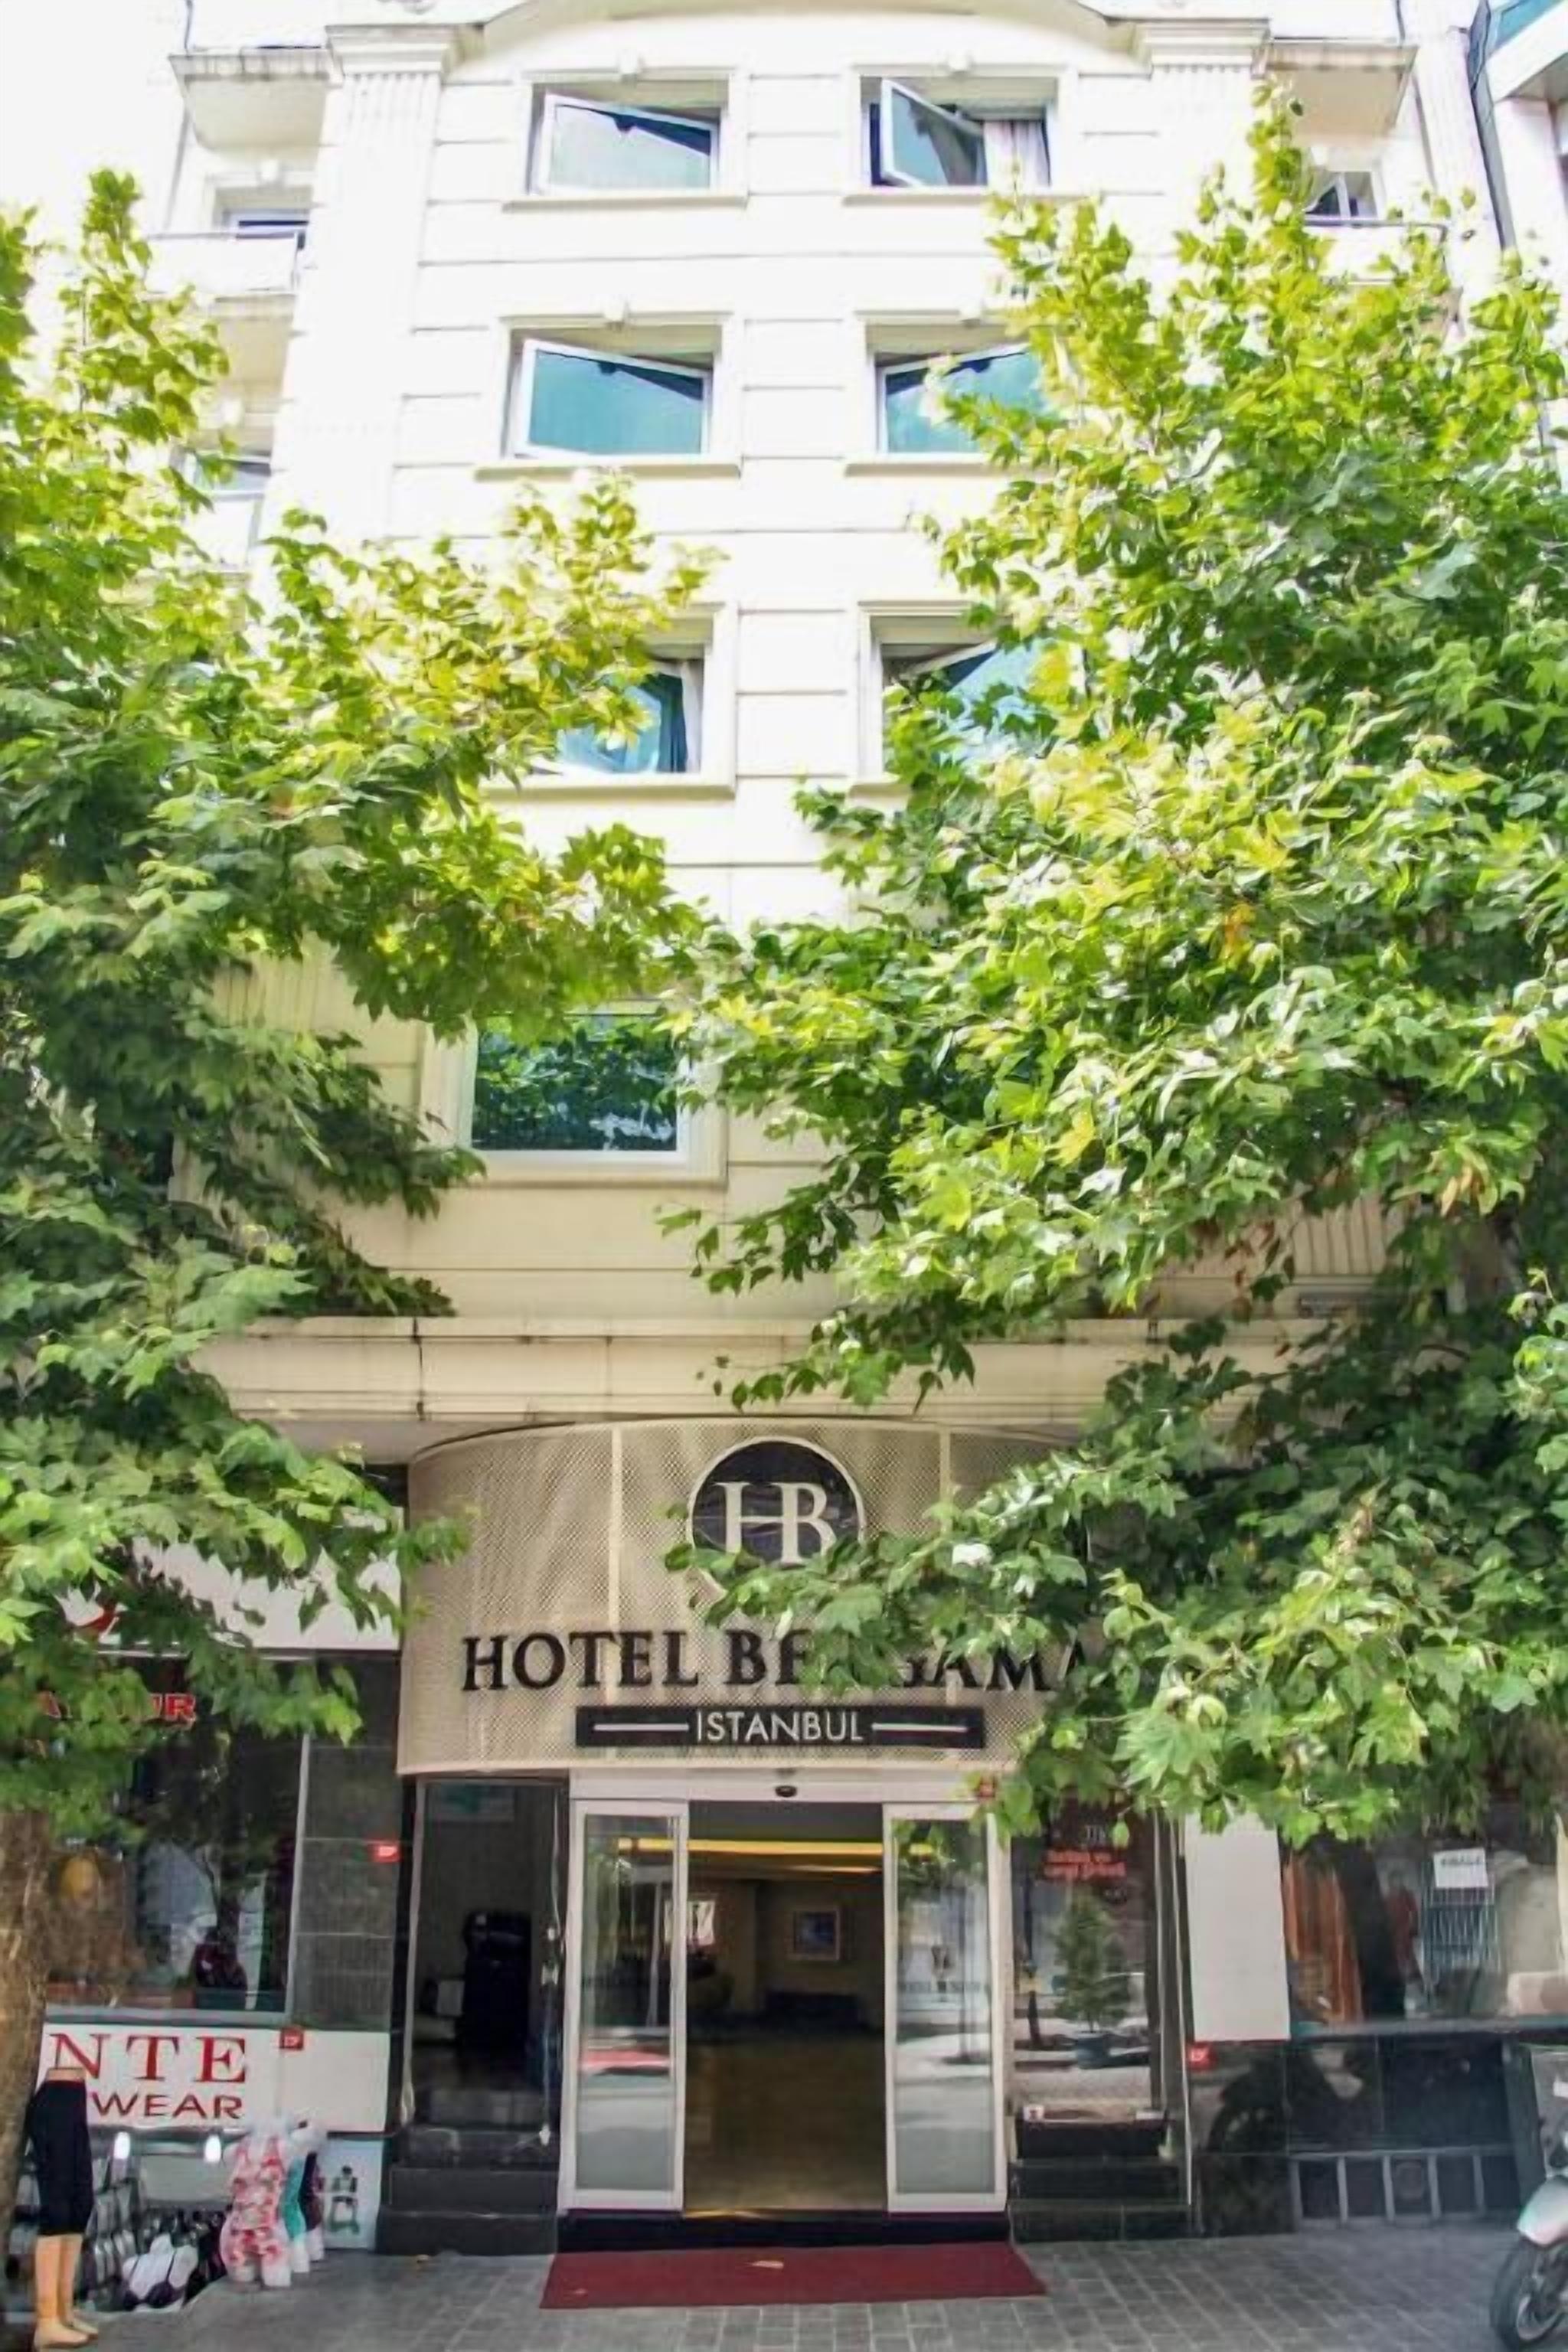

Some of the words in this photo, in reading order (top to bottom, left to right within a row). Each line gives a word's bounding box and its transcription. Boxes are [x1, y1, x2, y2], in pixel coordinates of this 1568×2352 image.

[462, 1629, 699, 1690] HOTEL
[696, 1710, 864, 1743] ISTANBUL
[91, 2092, 243, 2119] WEAR
